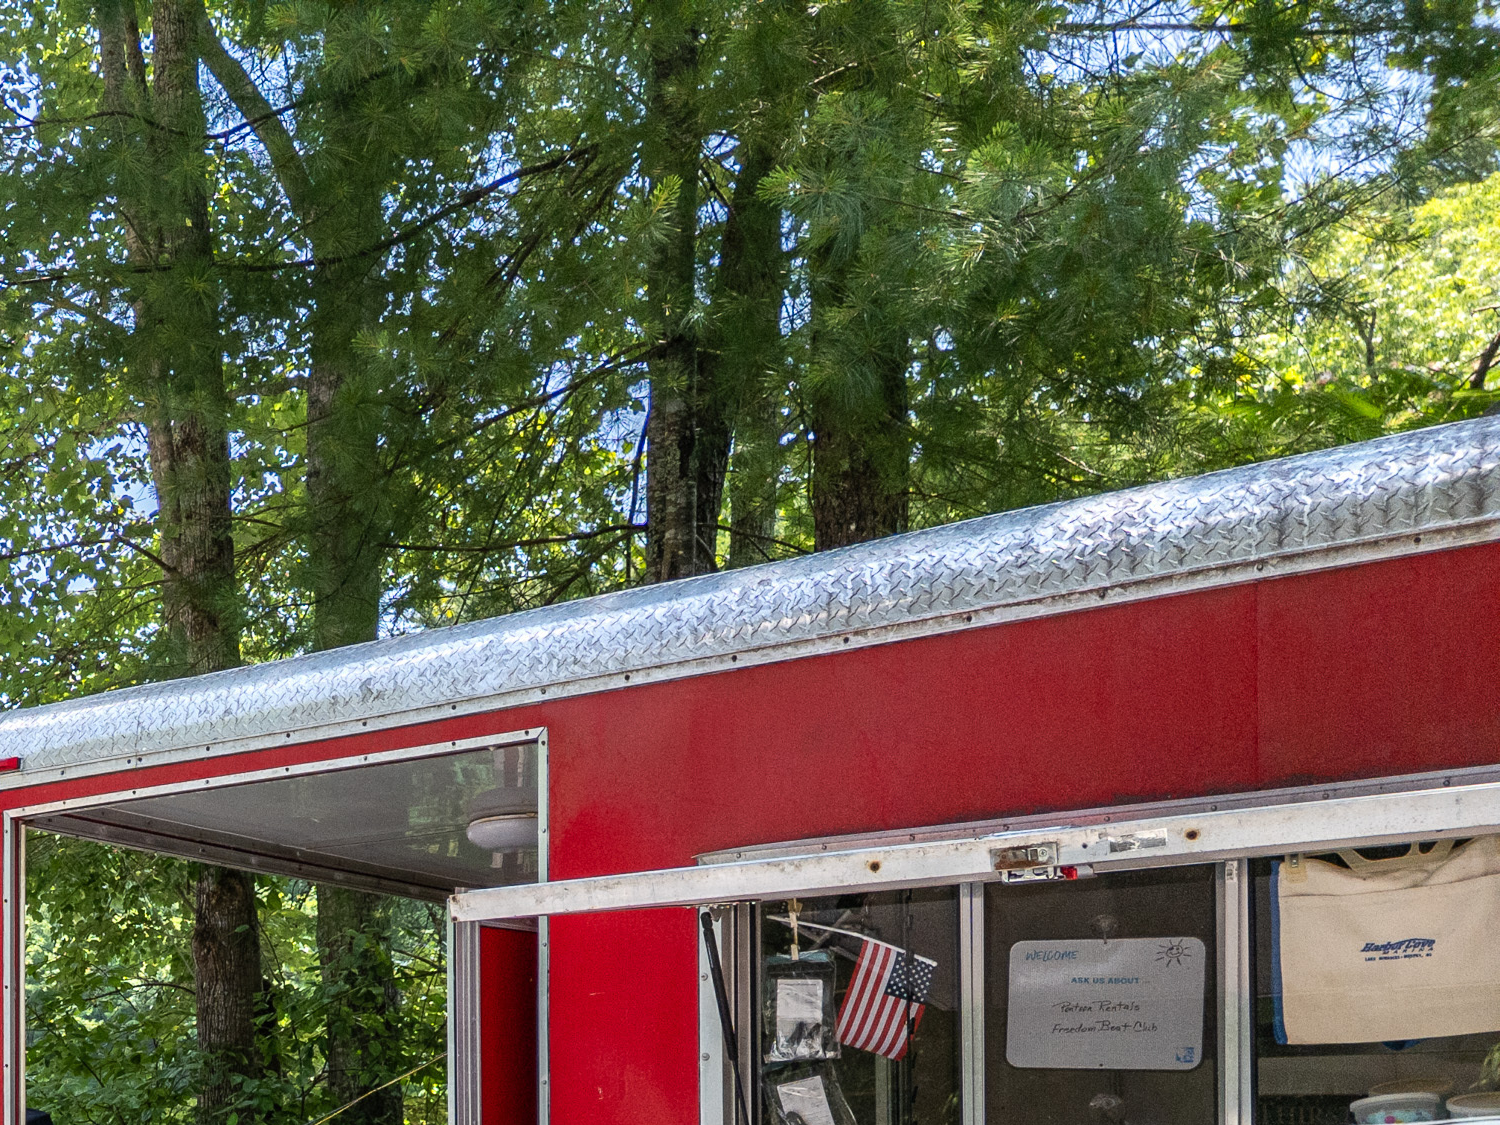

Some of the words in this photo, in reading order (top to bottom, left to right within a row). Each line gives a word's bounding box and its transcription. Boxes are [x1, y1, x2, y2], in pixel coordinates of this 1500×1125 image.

[1360, 941, 1405, 952] Harbor
[1405, 938, 1436, 949] Cove
[1025, 950, 1079, 961] WELCOME
[1092, 1000, 1140, 1012] Rentals
[1051, 1023, 1097, 1034] Freedom
[1133, 1020, 1158, 1033] Club
